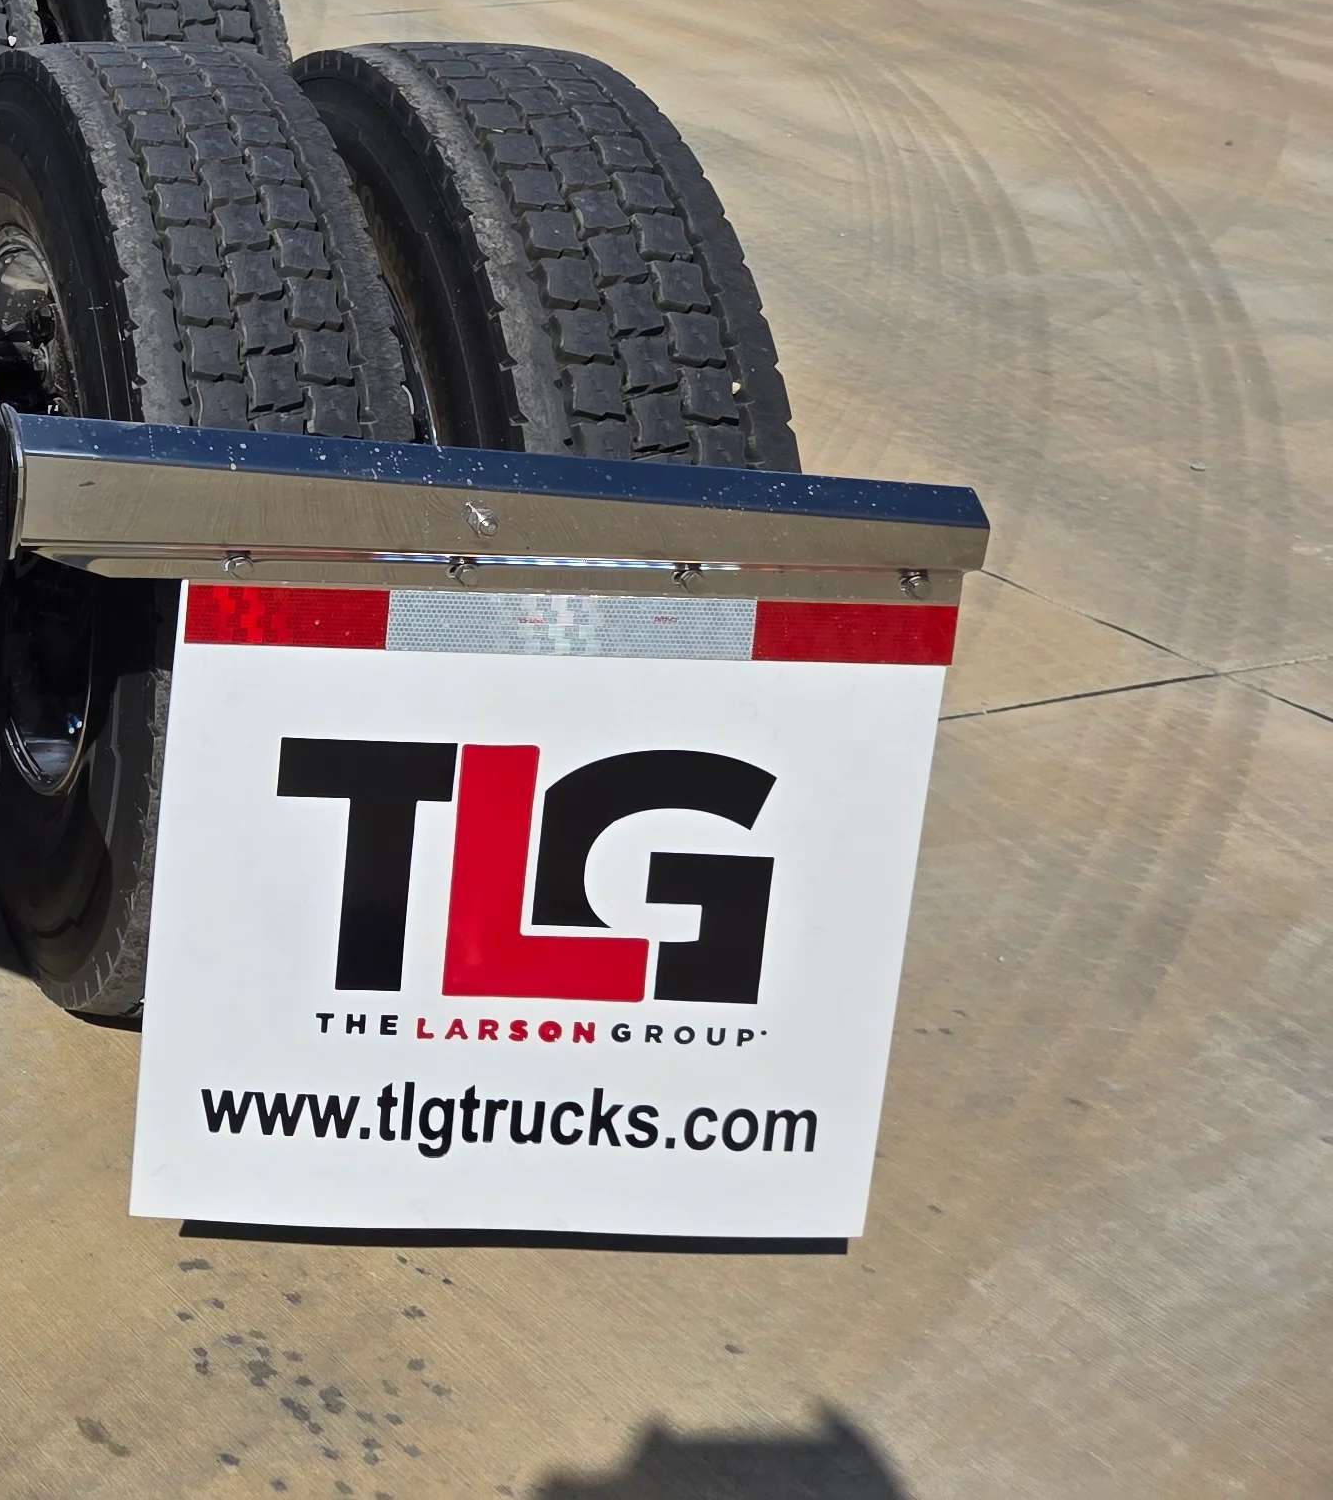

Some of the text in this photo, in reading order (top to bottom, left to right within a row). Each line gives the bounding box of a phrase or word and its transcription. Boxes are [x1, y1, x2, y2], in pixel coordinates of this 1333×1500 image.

[276, 736, 778, 1005] TLG
[315, 1012, 399, 1036] THE
[416, 1017, 596, 1044] LARSON
[200, 1081, 818, 1159] www.tlgtrucks.com
